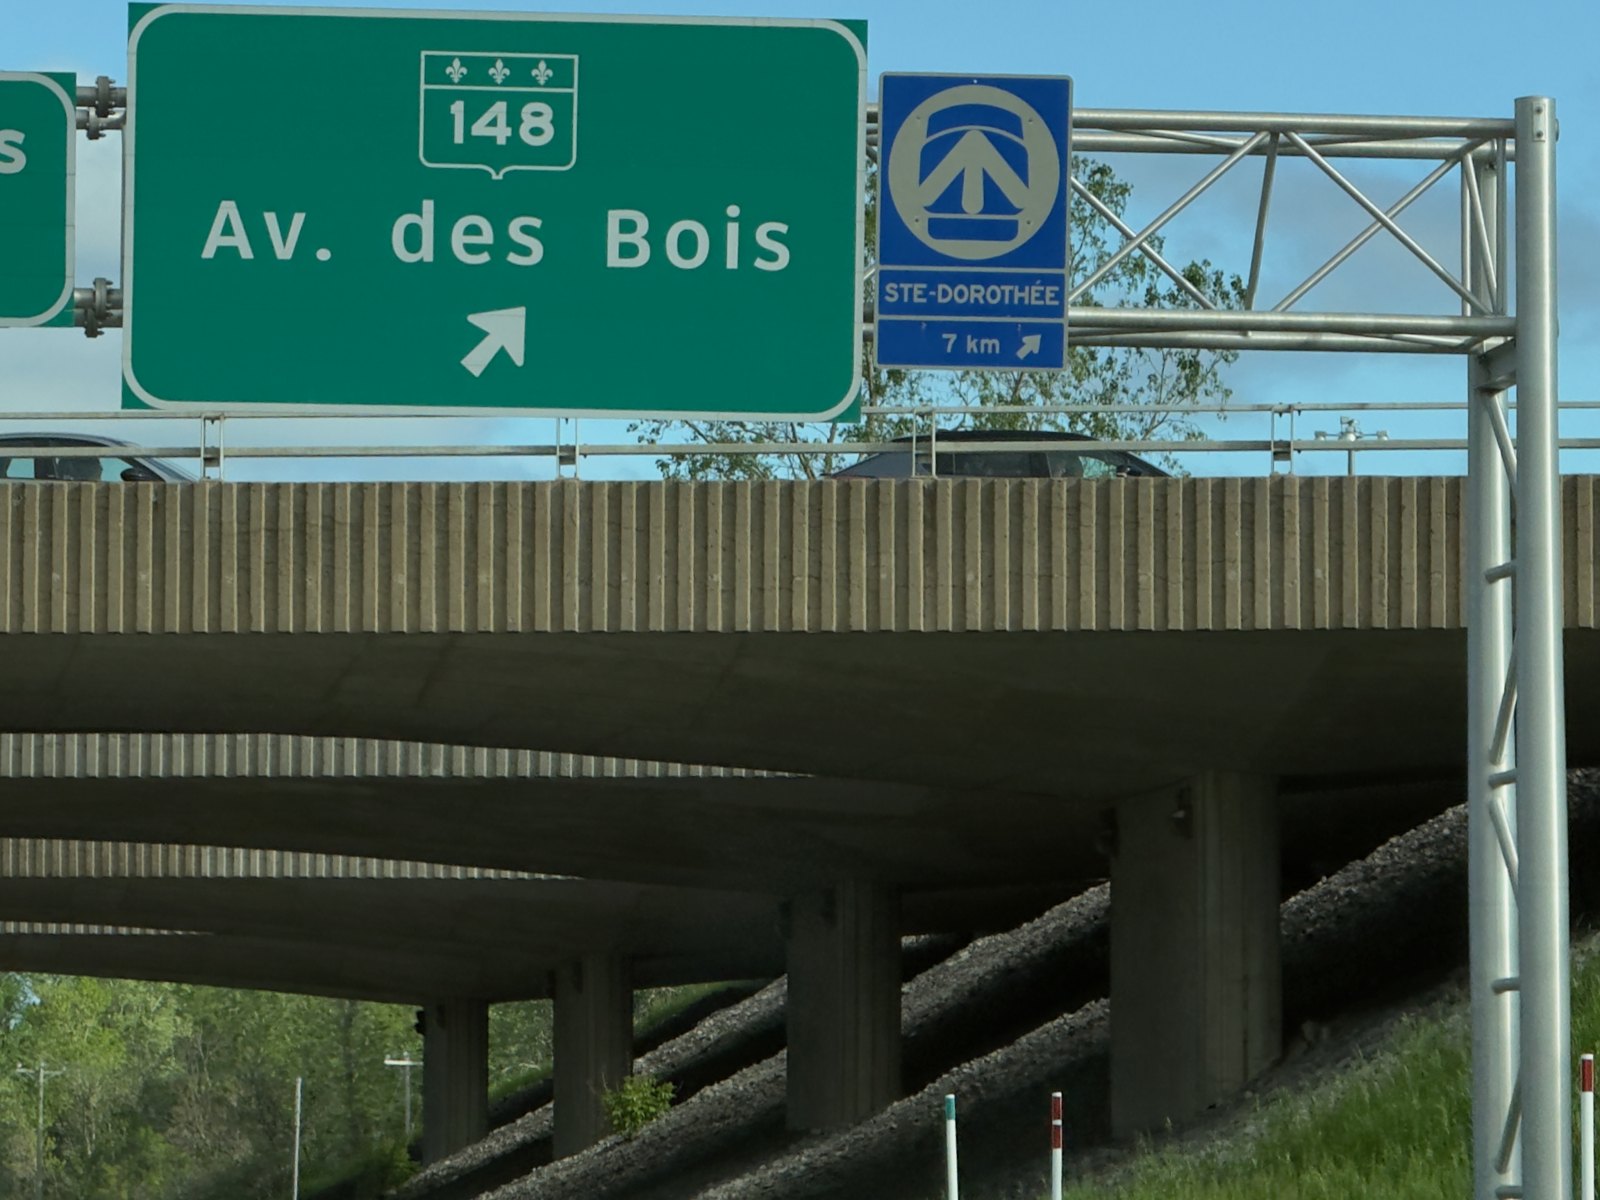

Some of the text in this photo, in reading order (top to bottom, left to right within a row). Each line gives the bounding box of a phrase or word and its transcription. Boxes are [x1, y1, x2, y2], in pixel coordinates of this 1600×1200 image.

[450, 101, 554, 146] 148
[201, 199, 790, 272] Av. des Bois
[884, 280, 1059, 305] STE-DOROTHÉE
[941, 333, 1000, 354] 7 km
